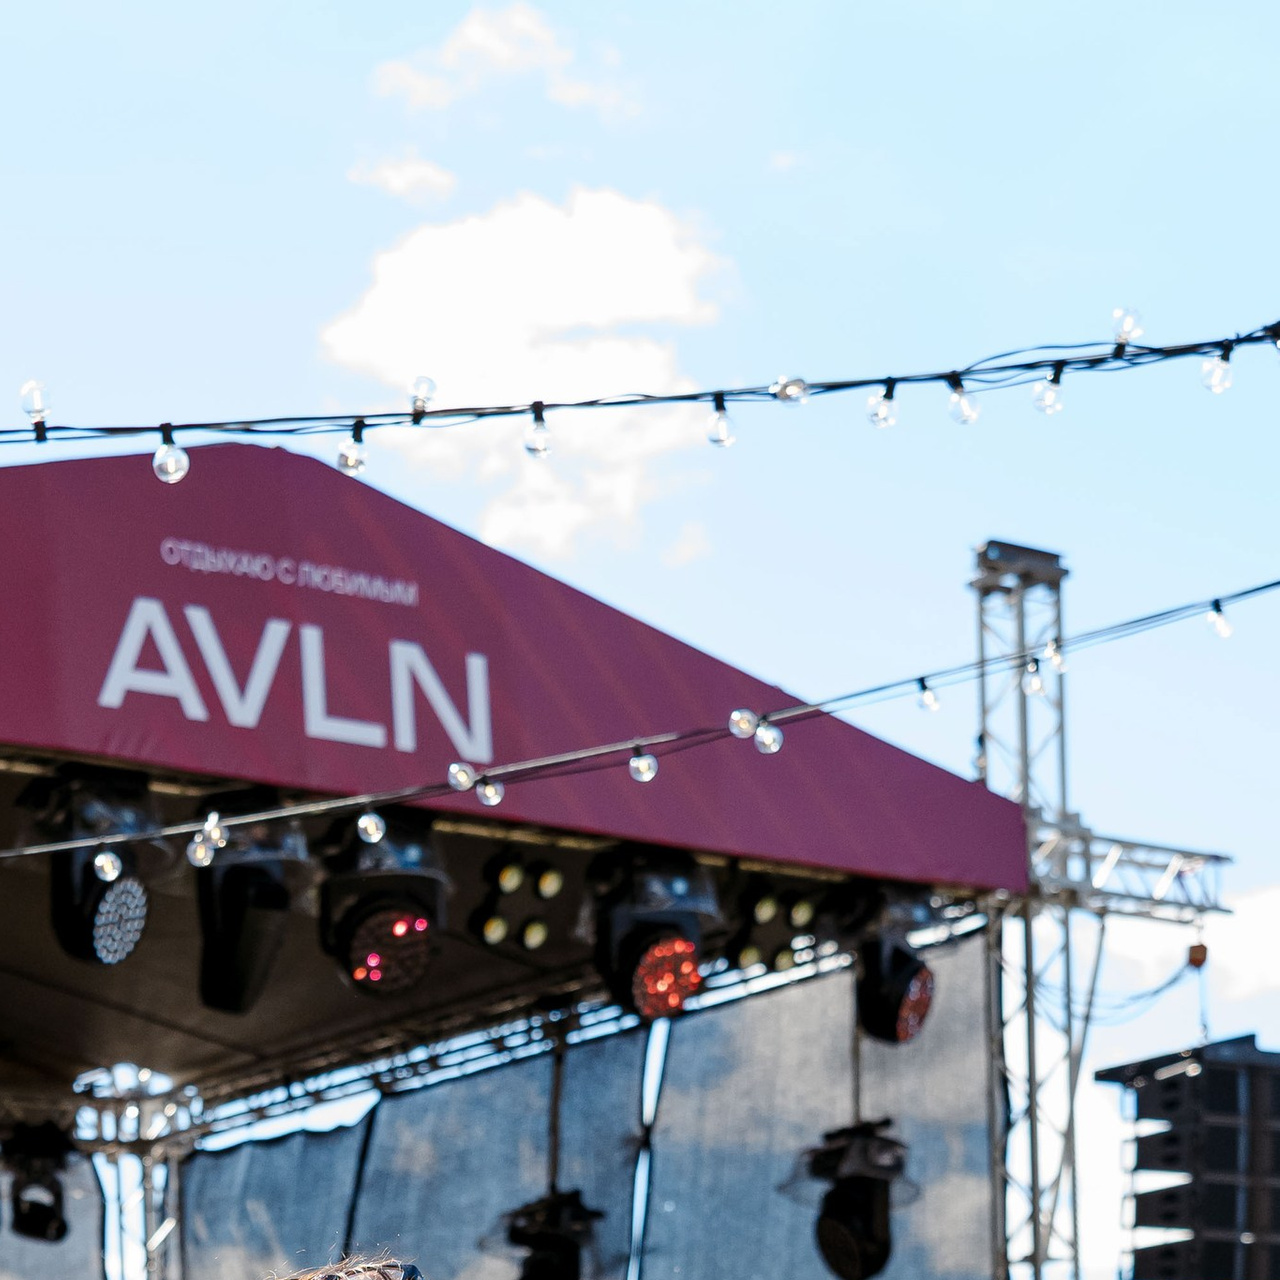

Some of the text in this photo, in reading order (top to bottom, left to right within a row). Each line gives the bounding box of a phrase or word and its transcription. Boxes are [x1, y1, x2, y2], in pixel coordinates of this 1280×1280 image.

[160, 536, 276, 581] ОТДЫХАЮ
[276, 556, 297, 585] С
[97, 596, 493, 763] AVLN
